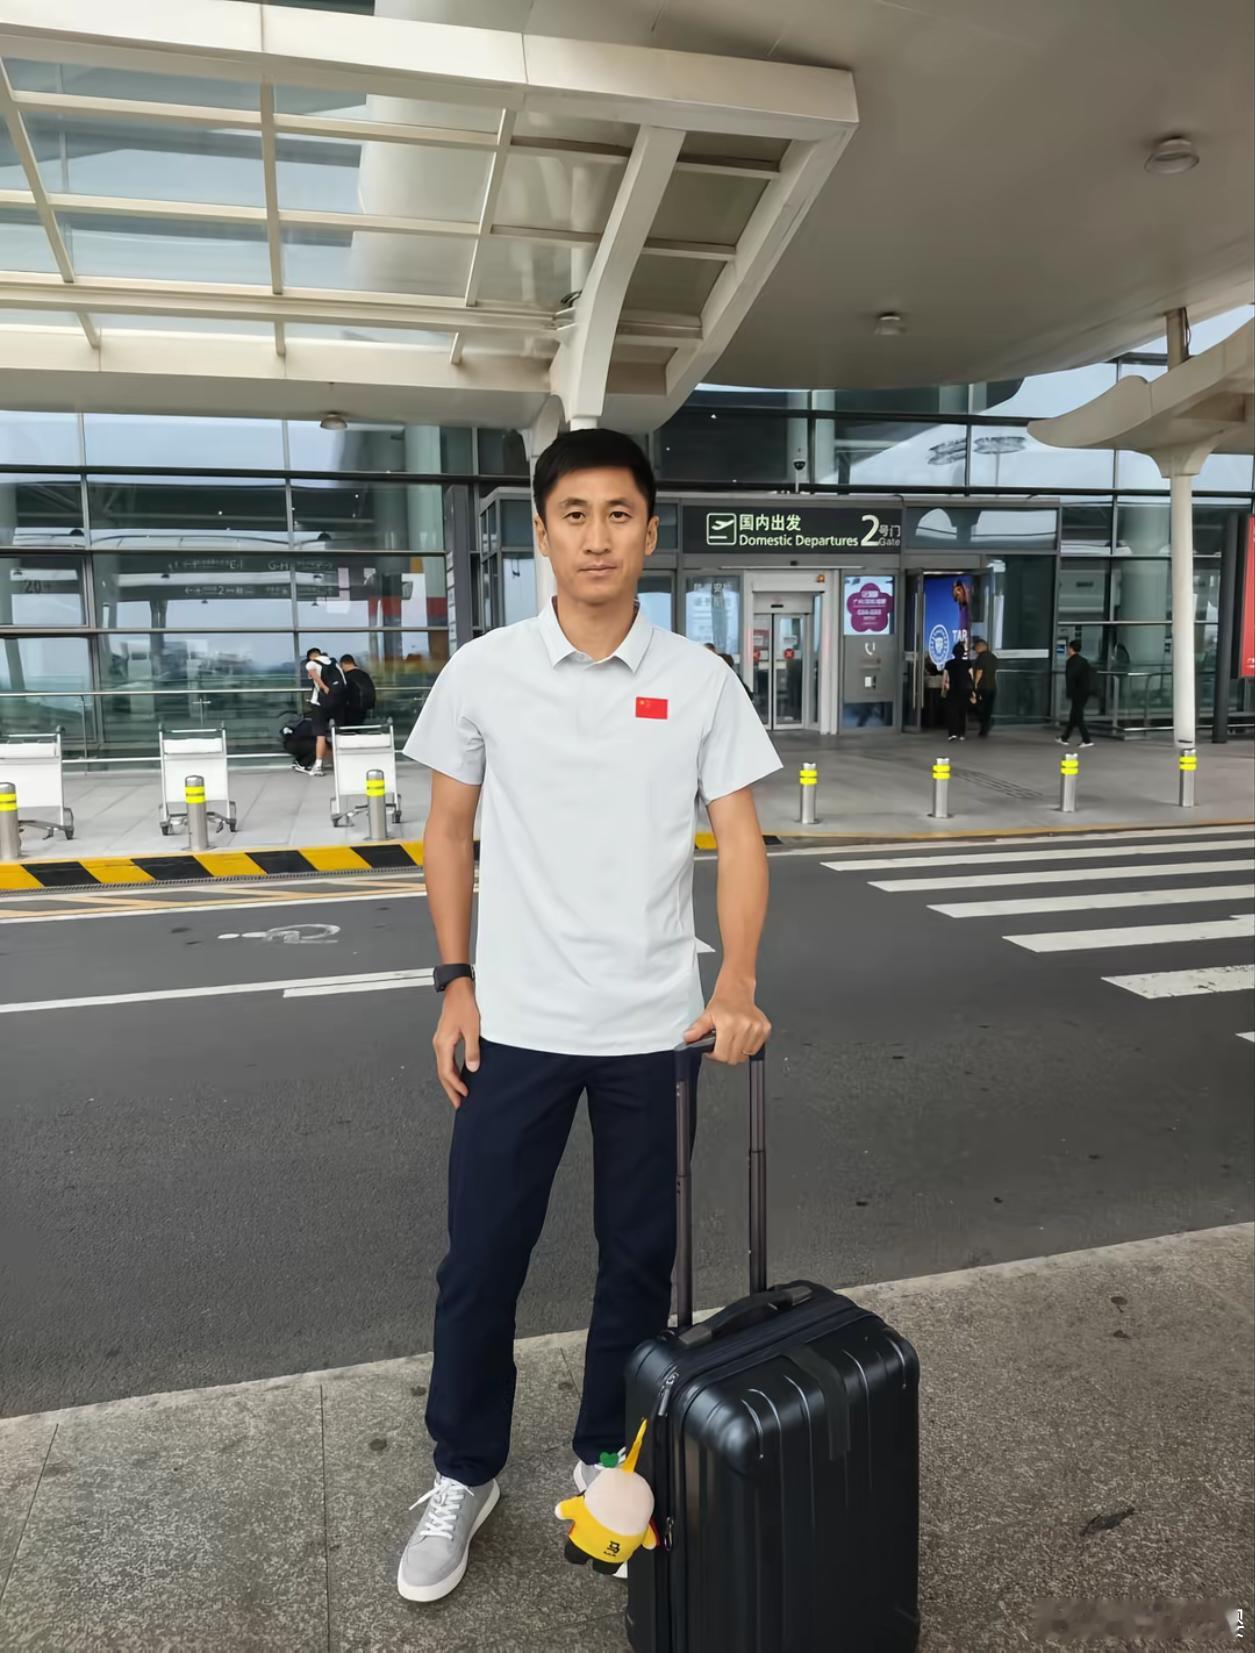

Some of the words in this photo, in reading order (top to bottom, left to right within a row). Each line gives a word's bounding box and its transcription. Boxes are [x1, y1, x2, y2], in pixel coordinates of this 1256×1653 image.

[739, 514, 801, 531] 国内出发
[860, 514, 880, 547] 2
[879, 524, 901, 537] 号门
[739, 534, 792, 546] Domestic
[795, 535, 858, 549] Departures
[879, 537, 901, 546] Gate
